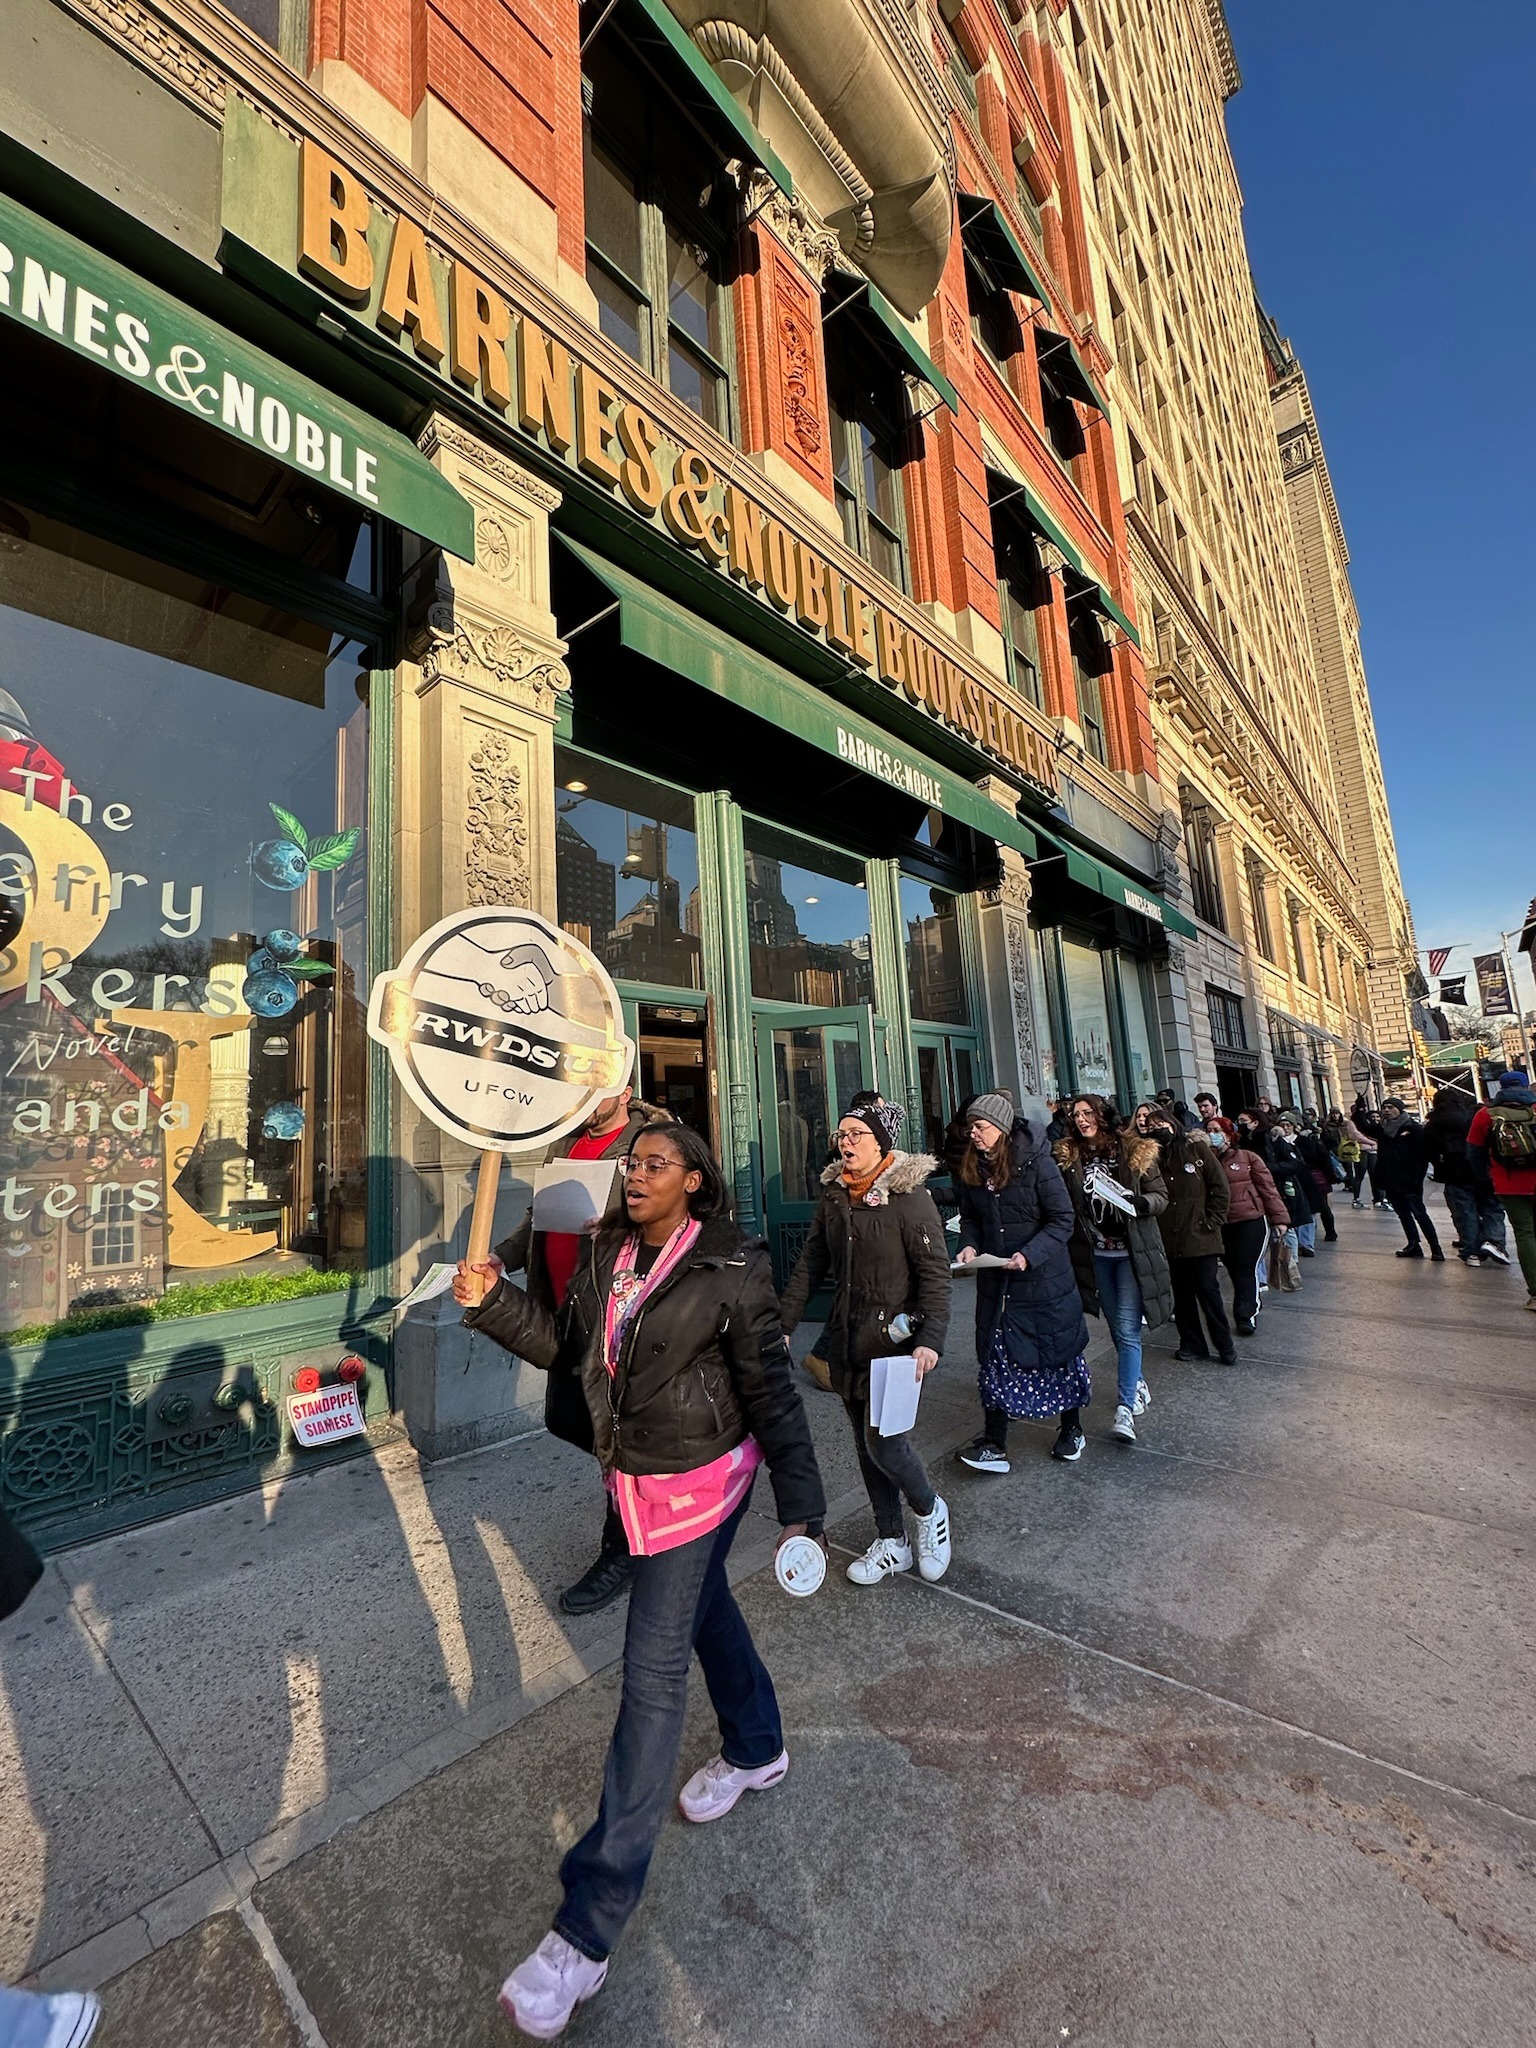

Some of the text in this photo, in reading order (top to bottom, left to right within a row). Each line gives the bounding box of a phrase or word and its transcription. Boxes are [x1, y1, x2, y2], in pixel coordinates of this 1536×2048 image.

[875, 608, 1060, 796] BOOKSELLERS
[8, 766, 134, 832] The
[26, 941, 237, 1018] kers
[6, 1026, 135, 1077] Novel
[410, 1011, 596, 1074] RWDSU
[13, 1087, 190, 1133] anda
[464, 1079, 534, 1106] UFCW
[0, 1176, 160, 1221] ters
[293, 1391, 354, 1420] STANDPIPE
[305, 1413, 354, 1437] SIAMESE
